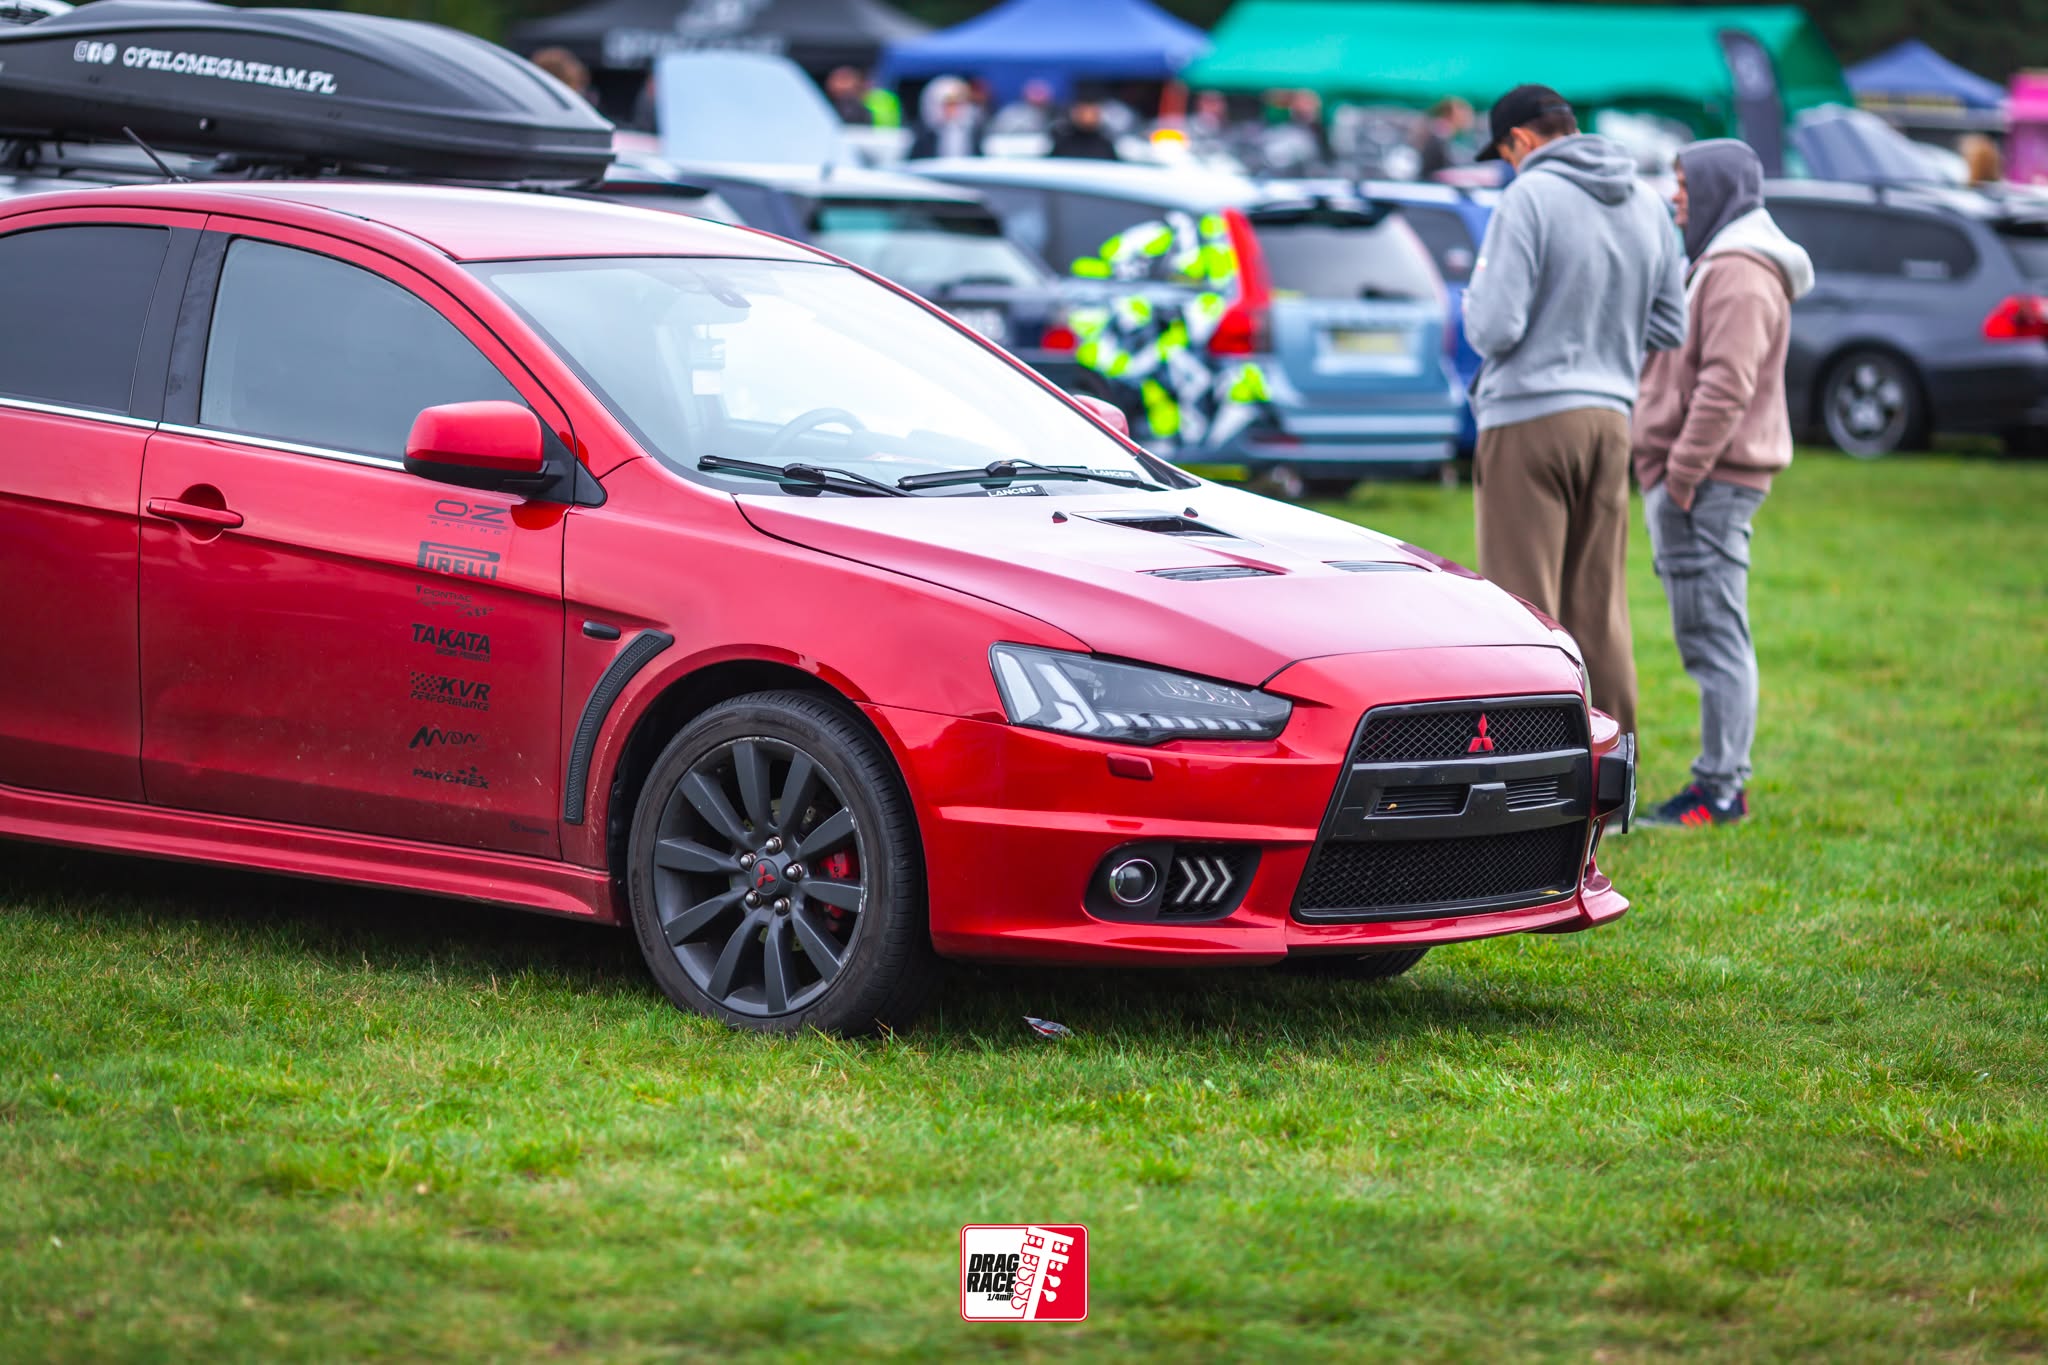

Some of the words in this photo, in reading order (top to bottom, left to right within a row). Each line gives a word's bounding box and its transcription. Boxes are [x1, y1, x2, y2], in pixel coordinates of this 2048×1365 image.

[123, 46, 337, 94] OPELOMEGATEAM.PL
[1093, 469, 1134, 478] LANCER
[987, 486, 1036, 497] LANCER
[416, 541, 501, 580] PIRELLI
[423, 587, 473, 602] PONTIAC
[411, 623, 491, 654] TAKATA
[439, 676, 491, 701] KVR
[413, 768, 489, 789] PAYCHEX
